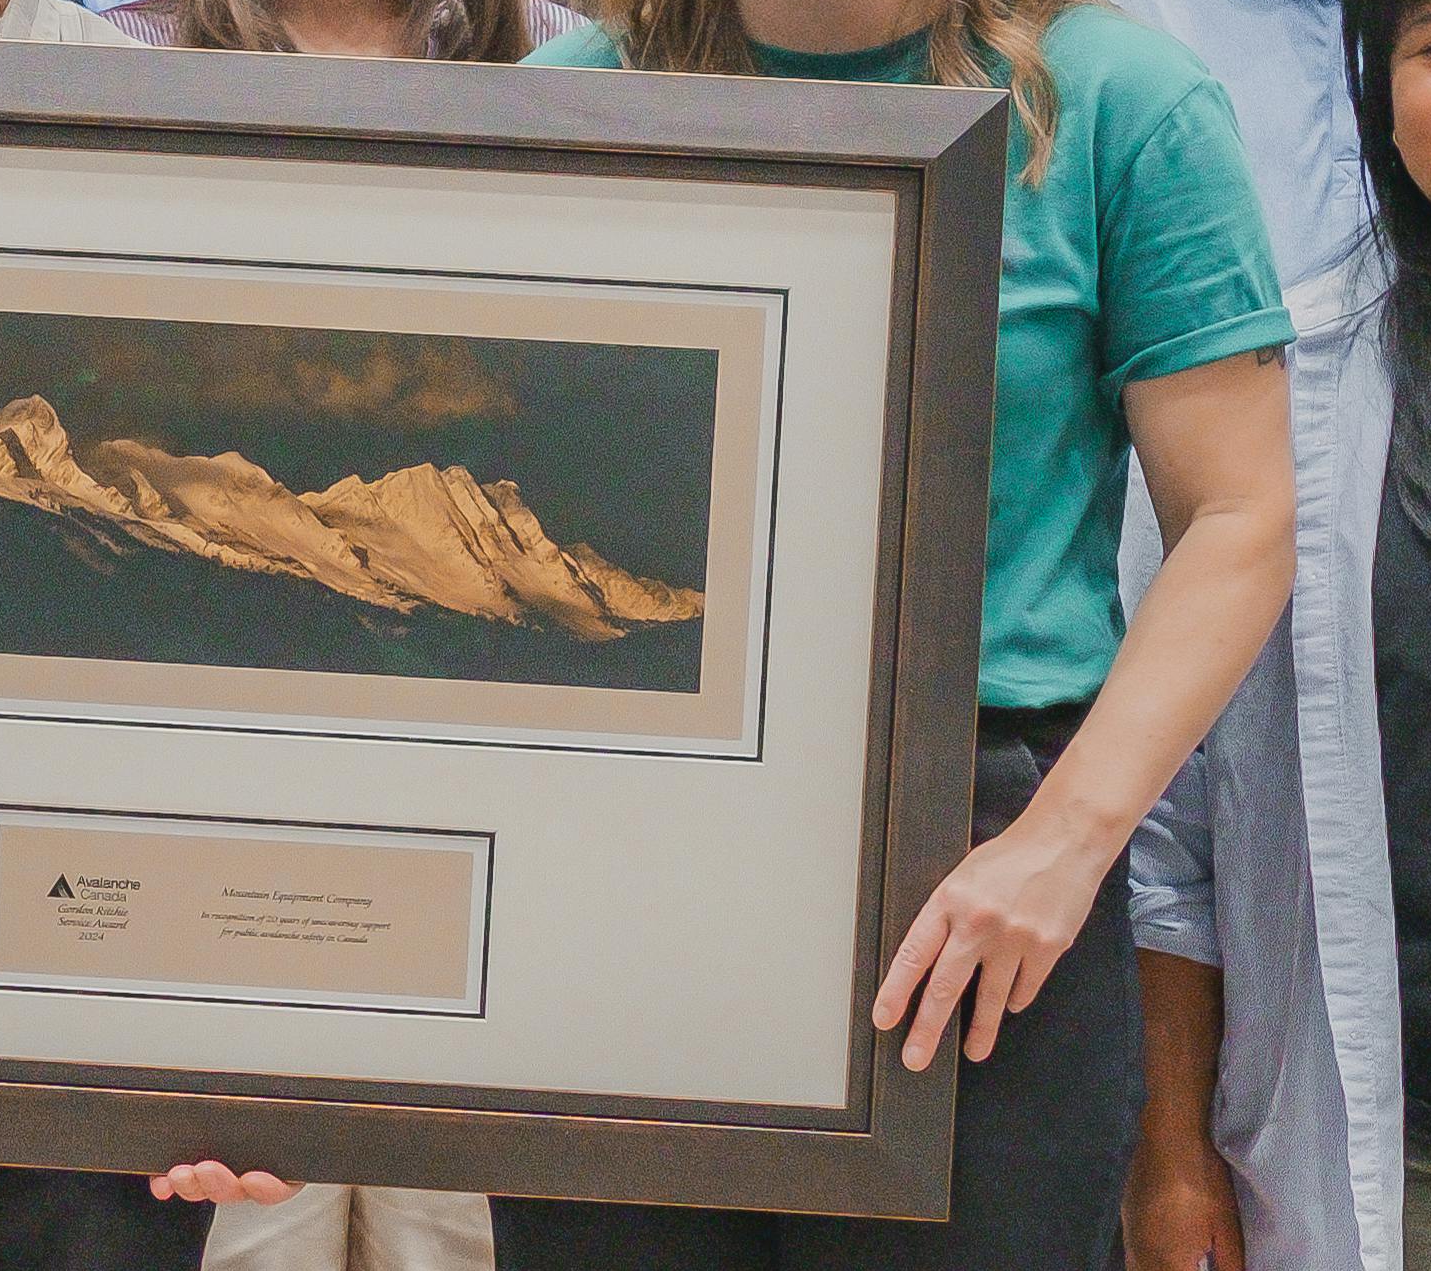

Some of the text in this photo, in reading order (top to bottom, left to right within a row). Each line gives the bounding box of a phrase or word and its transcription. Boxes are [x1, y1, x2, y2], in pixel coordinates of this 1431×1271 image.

[77, 875, 141, 890] Avalanche
[80, 889, 127, 903] Canada
[221, 886, 373, 909] Mountain Equipment Company
[58, 904, 94, 915] Gordon
[57, 917, 129, 929] Service Award
[78, 932, 105, 942] 2024
[336, 934, 368, 945] Canada
